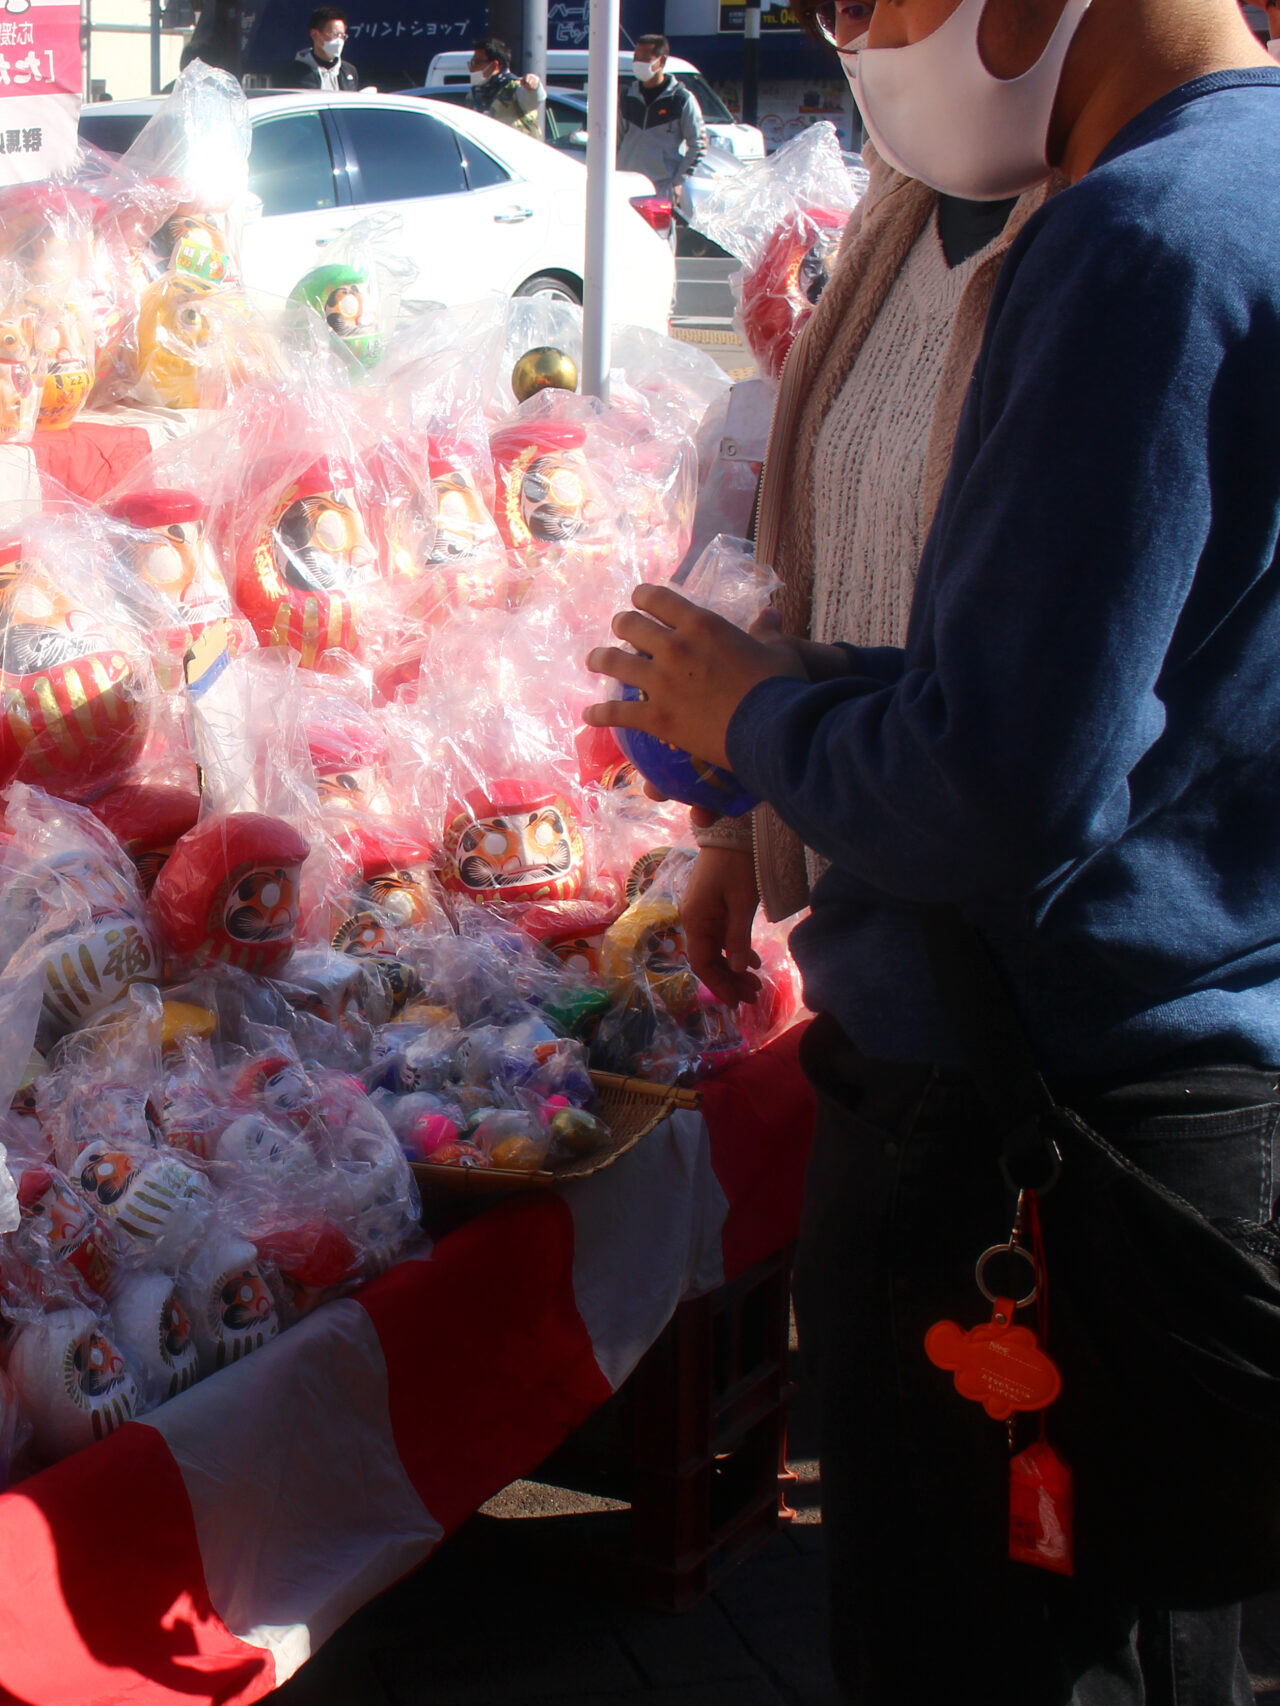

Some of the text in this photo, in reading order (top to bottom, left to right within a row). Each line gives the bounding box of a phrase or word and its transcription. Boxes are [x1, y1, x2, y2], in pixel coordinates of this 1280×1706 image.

[349, 19, 470, 38] プリントショップ
[556, 22, 589, 44] ビッ
